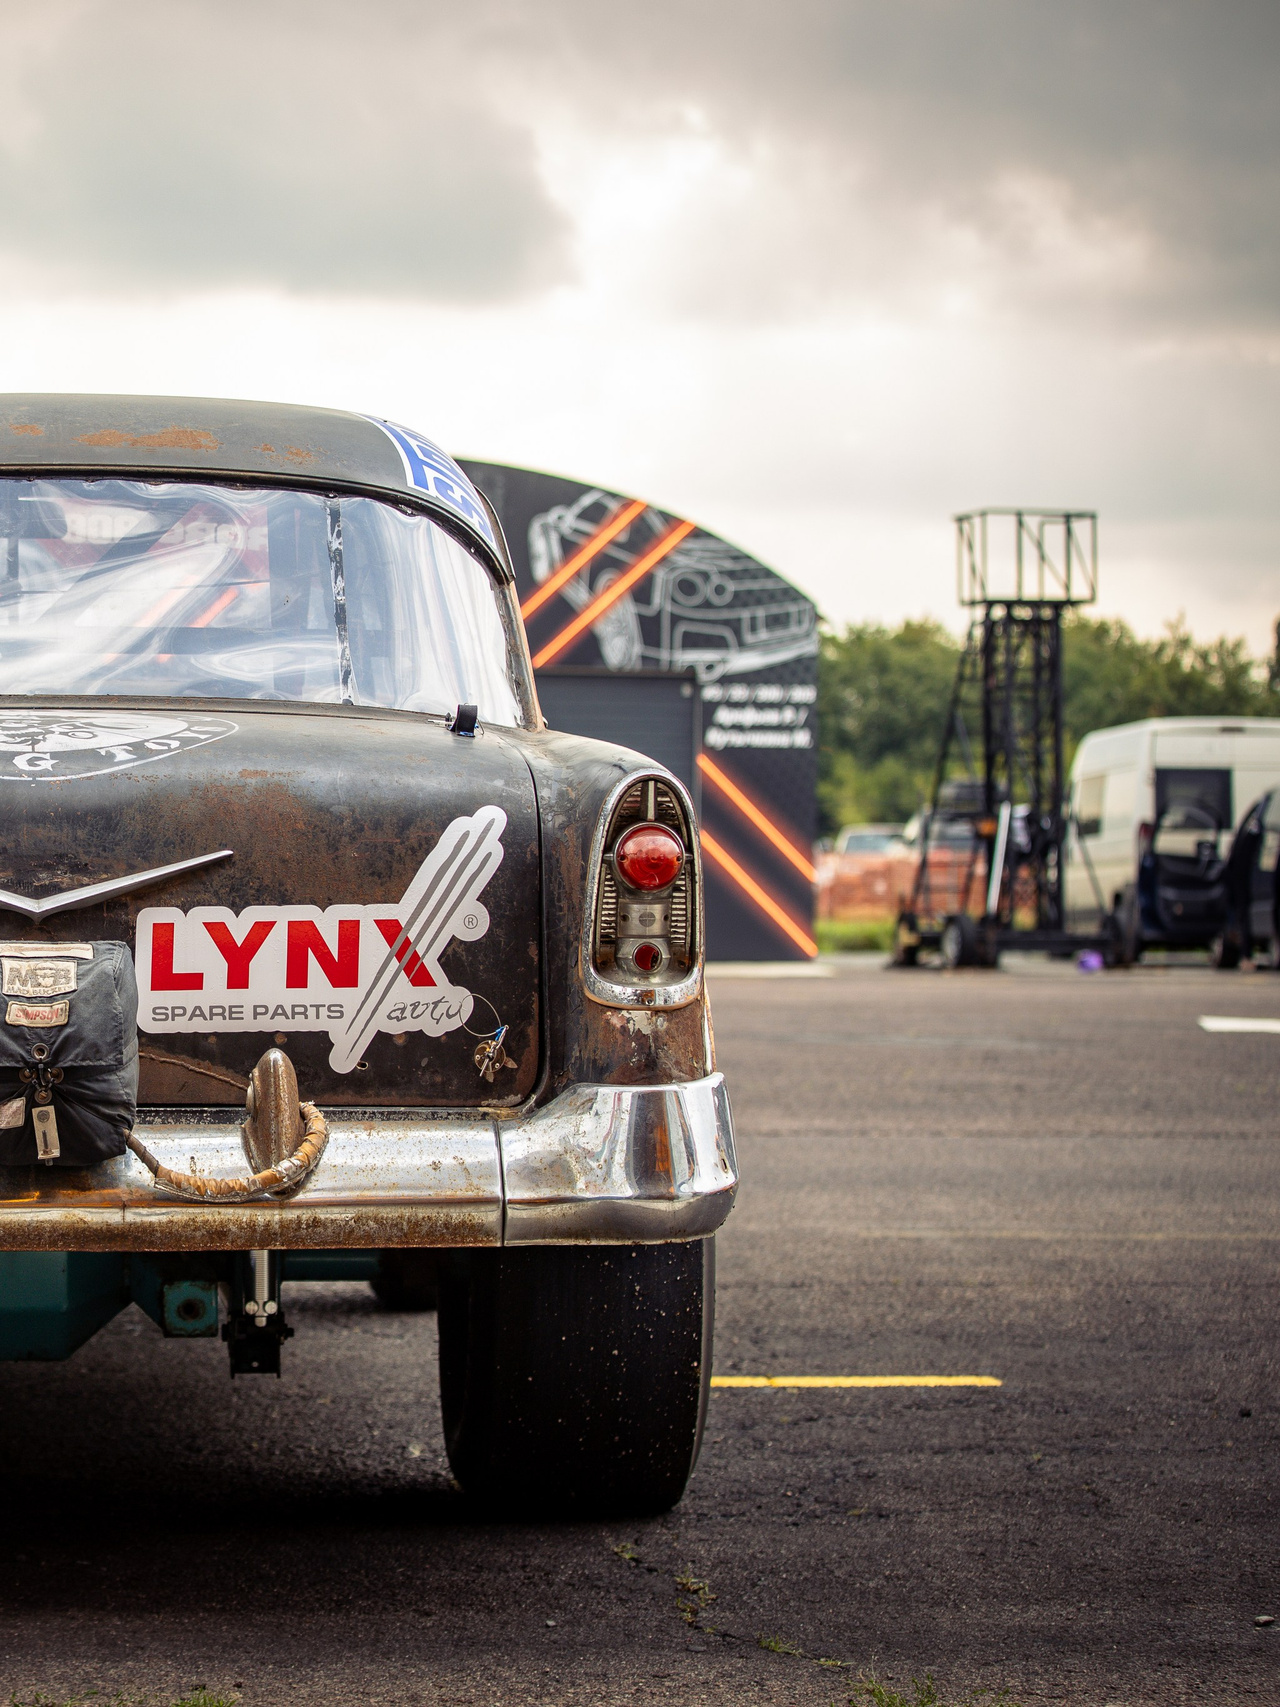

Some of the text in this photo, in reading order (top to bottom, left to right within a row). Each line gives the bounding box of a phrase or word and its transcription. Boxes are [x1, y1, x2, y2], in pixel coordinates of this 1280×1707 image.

[96, 725, 228, 762] TOYS
[151, 919, 437, 991] LYNX
[15, 1007, 60, 1021] SIMPSON
[152, 1003, 344, 1021] SPARE PARTS
